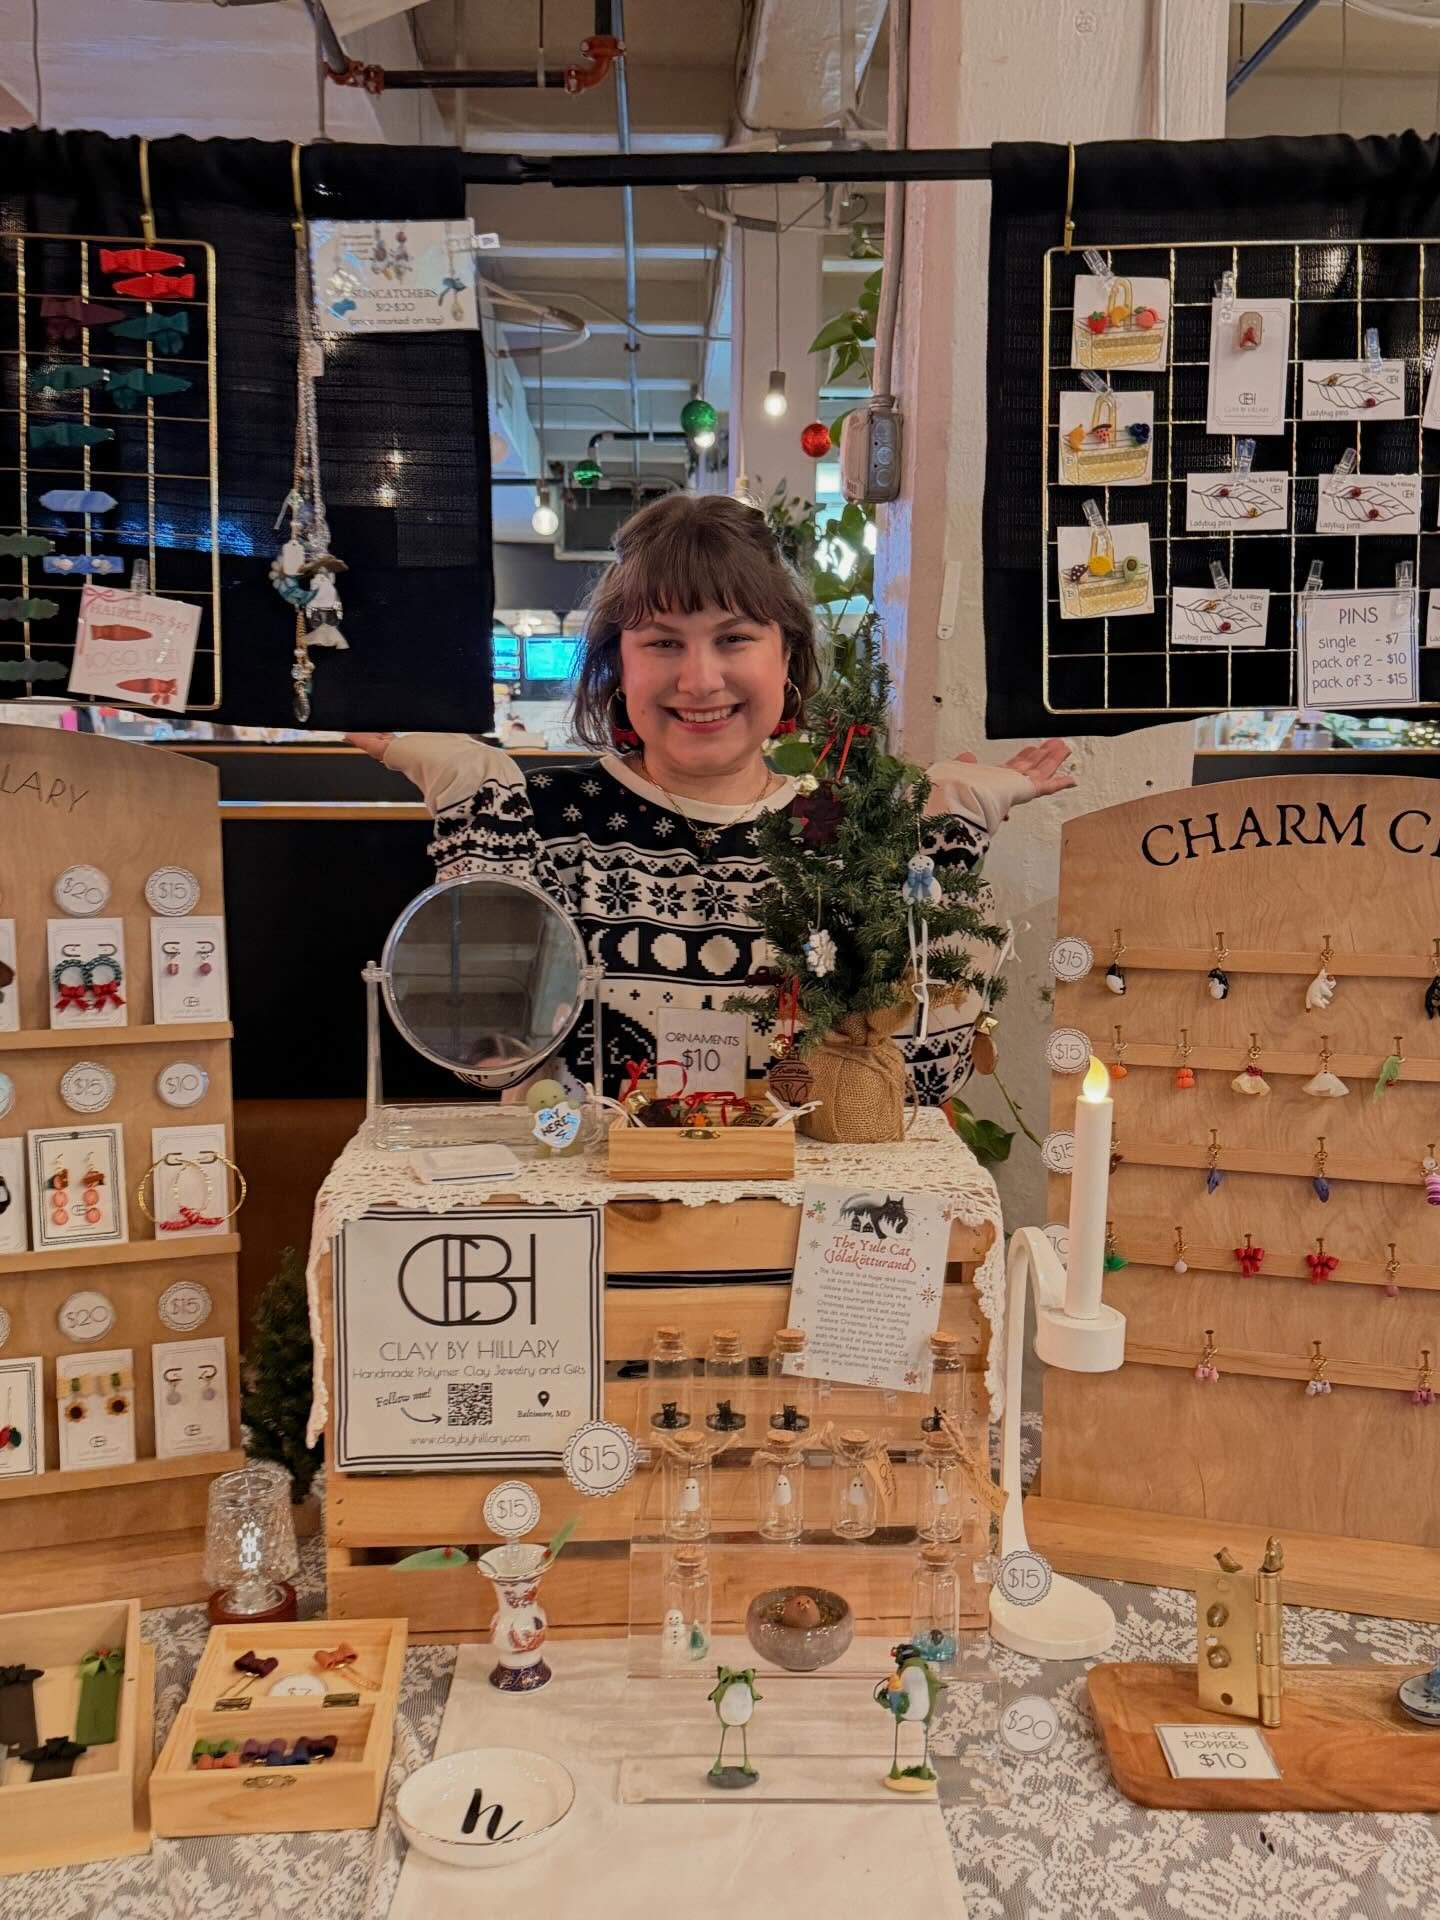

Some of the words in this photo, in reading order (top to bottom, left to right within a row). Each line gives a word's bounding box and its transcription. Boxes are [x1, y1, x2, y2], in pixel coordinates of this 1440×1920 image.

[1306, 409, 1334, 418] Ladybug
[1335, 409, 1349, 418] pins
[1190, 519, 1217, 529] Ladybug
[1218, 520, 1232, 529] pins
[1320, 522, 1345, 532] Ladybug
[1346, 522, 1360, 531] pins
[1339, 607, 1379, 624] PINS
[1174, 633, 1199, 643] Ladybug
[1318, 635, 1357, 653] single
[1385, 632, 1399, 645] $7
[1312, 656, 1343, 674] pack
[1345, 655, 1361, 668] of
[1364, 654, 1373, 667] 2
[1386, 652, 1407, 665] $10
[1312, 676, 1344, 694] pack
[1346, 675, 1361, 688] of
[1364, 675, 1373, 687] 3
[1387, 672, 1408, 686] $15
[1141, 802, 1368, 867] CHARM
[1389, 809, 1440, 858] C
[63, 877, 105, 905] $20
[158, 882, 189, 900] $15
[1057, 948, 1084, 969] $15
[665, 1032, 741, 1047] ORNAMENTS
[681, 1048, 721, 1072] $10
[1054, 1043, 1083, 1061] $15
[74, 1077, 105, 1097] $15
[165, 1074, 200, 1095] $10
[833, 1234, 855, 1250] The
[860, 1239, 887, 1254] Yule
[889, 1243, 912, 1257] Cat
[66, 1305, 109, 1329] $20
[172, 1296, 203, 1317] $15
[379, 1341, 439, 1362] CLAY
[447, 1340, 470, 1360] BY
[477, 1339, 560, 1360] HILLARY
[352, 1367, 414, 1379] Handmade
[417, 1366, 459, 1380] Polymer
[463, 1365, 490, 1379] Clay
[493, 1364, 536, 1379] Jewelry
[538, 1364, 561, 1376] and
[563, 1363, 586, 1376] Gifts
[376, 1390, 410, 1408] Follow
[412, 1386, 432, 1401] me!
[517, 1409, 554, 1419] Baltimore,
[556, 1409, 571, 1418] MD
[410, 1432, 531, 1446] www.claybyhillary.com
[579, 1445, 621, 1473] $15
[496, 1499, 528, 1519] $15
[1007, 1568, 1041, 1589] $15
[1005, 1710, 1053, 1740] $20
[1183, 1731, 1241, 1740] HINGE
[1182, 1741, 1249, 1750] TOPPERS
[1199, 1752, 1247, 1769] $10
[461, 1788, 525, 1841] h
